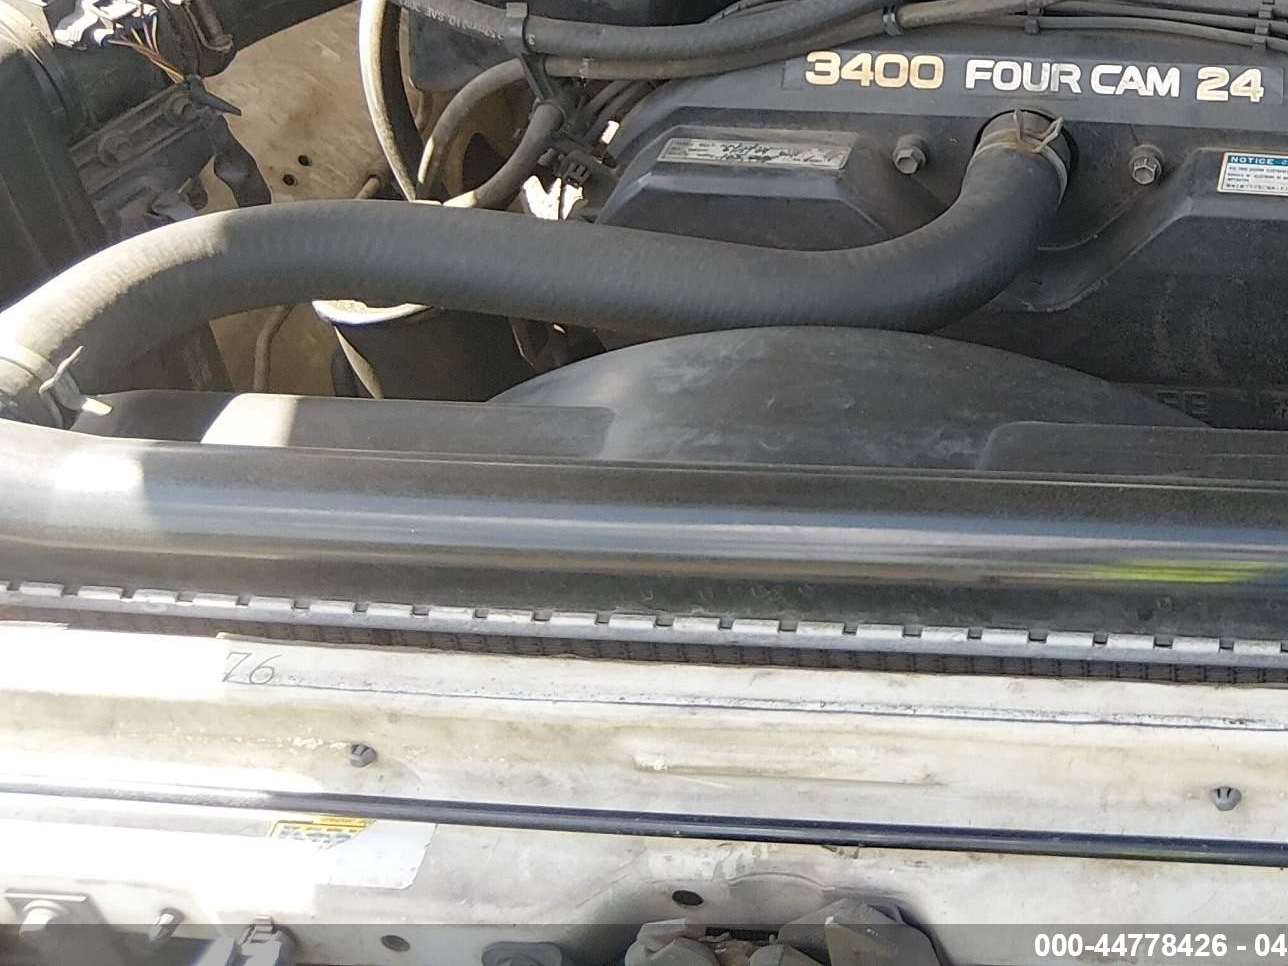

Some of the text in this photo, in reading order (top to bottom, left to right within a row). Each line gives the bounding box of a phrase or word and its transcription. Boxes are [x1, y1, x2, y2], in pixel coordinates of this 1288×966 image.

[806, 51, 1264, 102] 3400 FOUR CAM 24
[1230, 155, 1275, 166] NOTICE
[222, 651, 282, 684] 76
